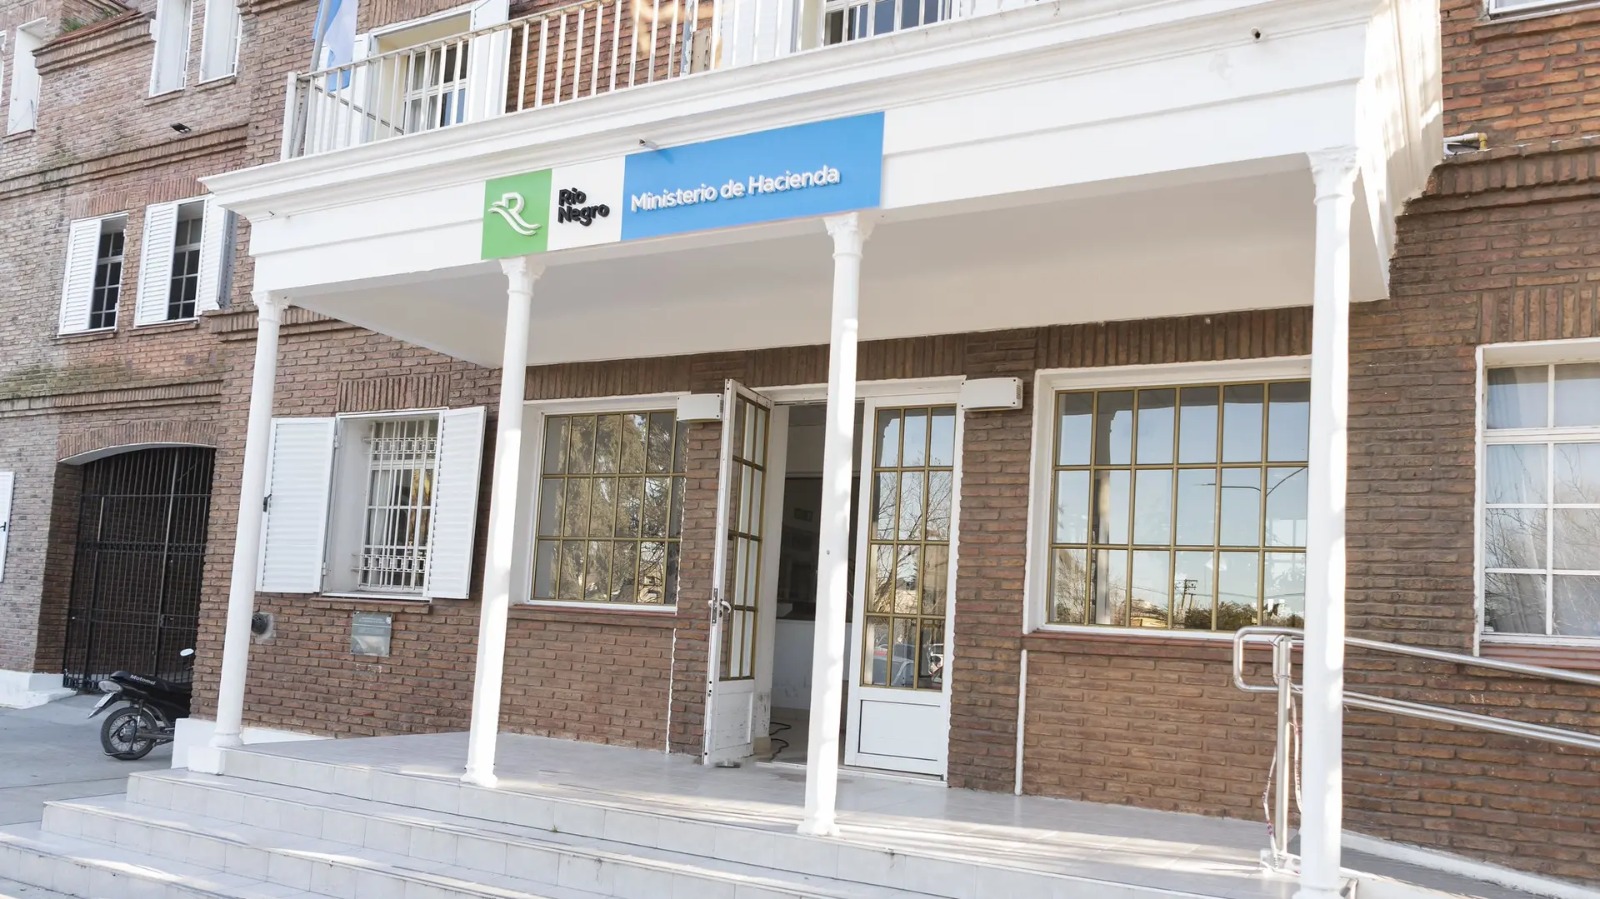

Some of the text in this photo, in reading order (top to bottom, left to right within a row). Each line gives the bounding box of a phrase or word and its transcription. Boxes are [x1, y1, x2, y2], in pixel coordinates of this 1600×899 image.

[630, 164, 842, 213] Ministerio de Hacienda
[557, 204, 611, 227] Negro
